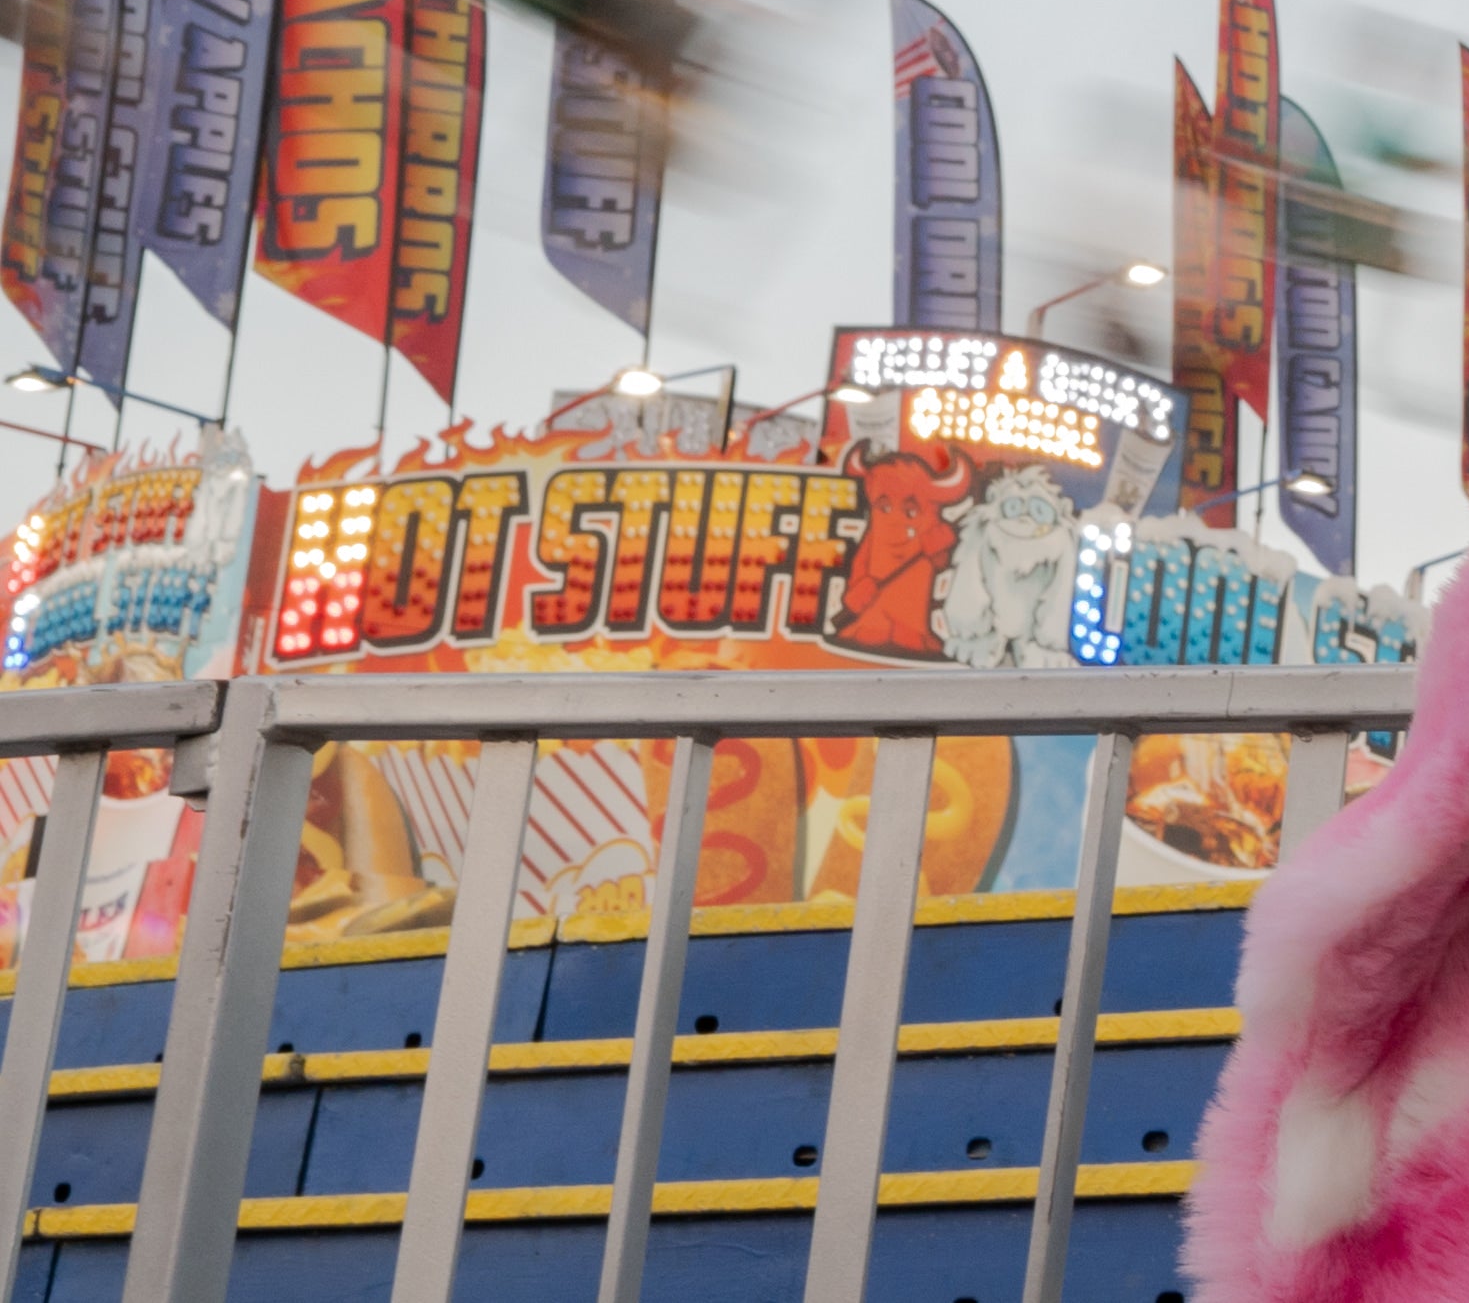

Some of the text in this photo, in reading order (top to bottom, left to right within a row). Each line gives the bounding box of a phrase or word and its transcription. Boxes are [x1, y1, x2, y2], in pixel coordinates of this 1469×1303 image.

[156, 23, 247, 246] APPLES
[910, 75, 980, 210] COOL
[1213, 1, 1269, 353] HOT DOGS
[1281, 353, 1341, 519] CANDY
[8, 493, 92, 595] HOT
[274, 470, 861, 658] HOT STUFF
[1070, 523, 1285, 666] COOL
